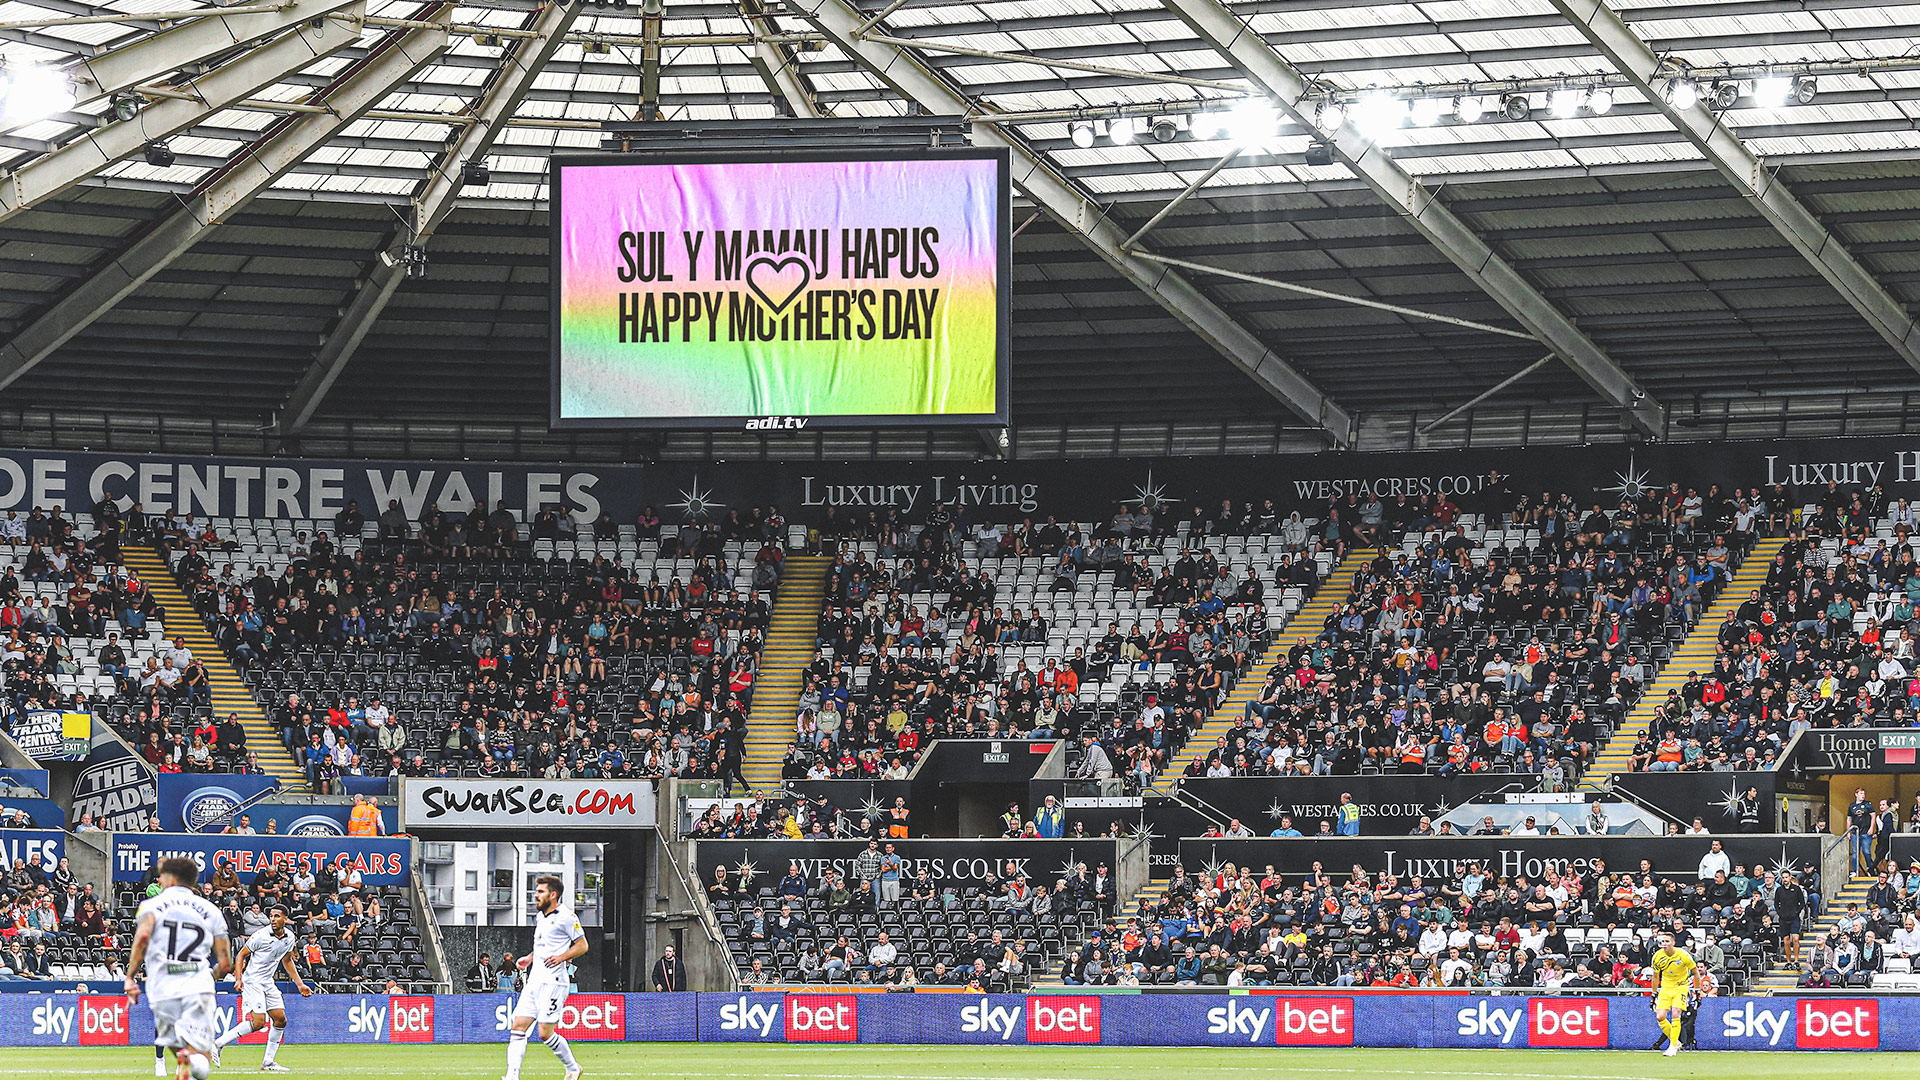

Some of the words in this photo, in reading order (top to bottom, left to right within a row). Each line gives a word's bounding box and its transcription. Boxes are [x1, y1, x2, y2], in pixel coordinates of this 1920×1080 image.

[617, 231, 673, 283] SUL
[684, 231, 704, 282] Y
[842, 226, 939, 279] HAPUS
[618, 291, 724, 343] HAPPY
[883, 288, 940, 340] DAY
[745, 417, 809, 429] adi.tv
[1293, 474, 1511, 500] WESTACRES.CO.
[1764, 455, 1885, 493] Luxury
[89, 460, 344, 520] CENTRE
[366, 469, 601, 525] WALES
[801, 476, 921, 514] Luxury
[931, 475, 1038, 513] Living
[17, 733, 60, 747] CENTRE
[28, 746, 51, 754] WALES
[64, 743, 81, 751] EXIT
[1819, 733, 1877, 752] Home
[1882, 735, 1906, 746] EXIT
[1826, 752, 1872, 770] Win!
[87, 762, 138, 792] THE
[72, 783, 157, 824] TRADE
[1291, 803, 1426, 818] WESTAES.CO.UK
[106, 809, 149, 832] NTRE
[117, 850, 151, 871] THE
[334, 851, 402, 875] CARS
[788, 858, 1033, 881] WESTRES.COUK
[1499, 850, 1600, 879] Homes
[163, 920, 205, 962] 12
[348, 998, 387, 1040] sky
[393, 1000, 430, 1032] bet
[549, 999, 558, 1011] 3
[557, 1000, 619, 1030] bet
[719, 996, 779, 1037] sky
[792, 999, 850, 1031] bet
[960, 998, 1022, 1040] sky
[1034, 1000, 1093, 1032] bet
[31, 998, 75, 1043] sky
[83, 999, 124, 1034] bet
[1207, 999, 1271, 1042] sky
[1284, 1002, 1346, 1034] bet
[1457, 999, 1523, 1044] sky
[1536, 1002, 1600, 1035] bet
[1723, 1001, 1790, 1046] sky
[1805, 1003, 1870, 1037] bet
